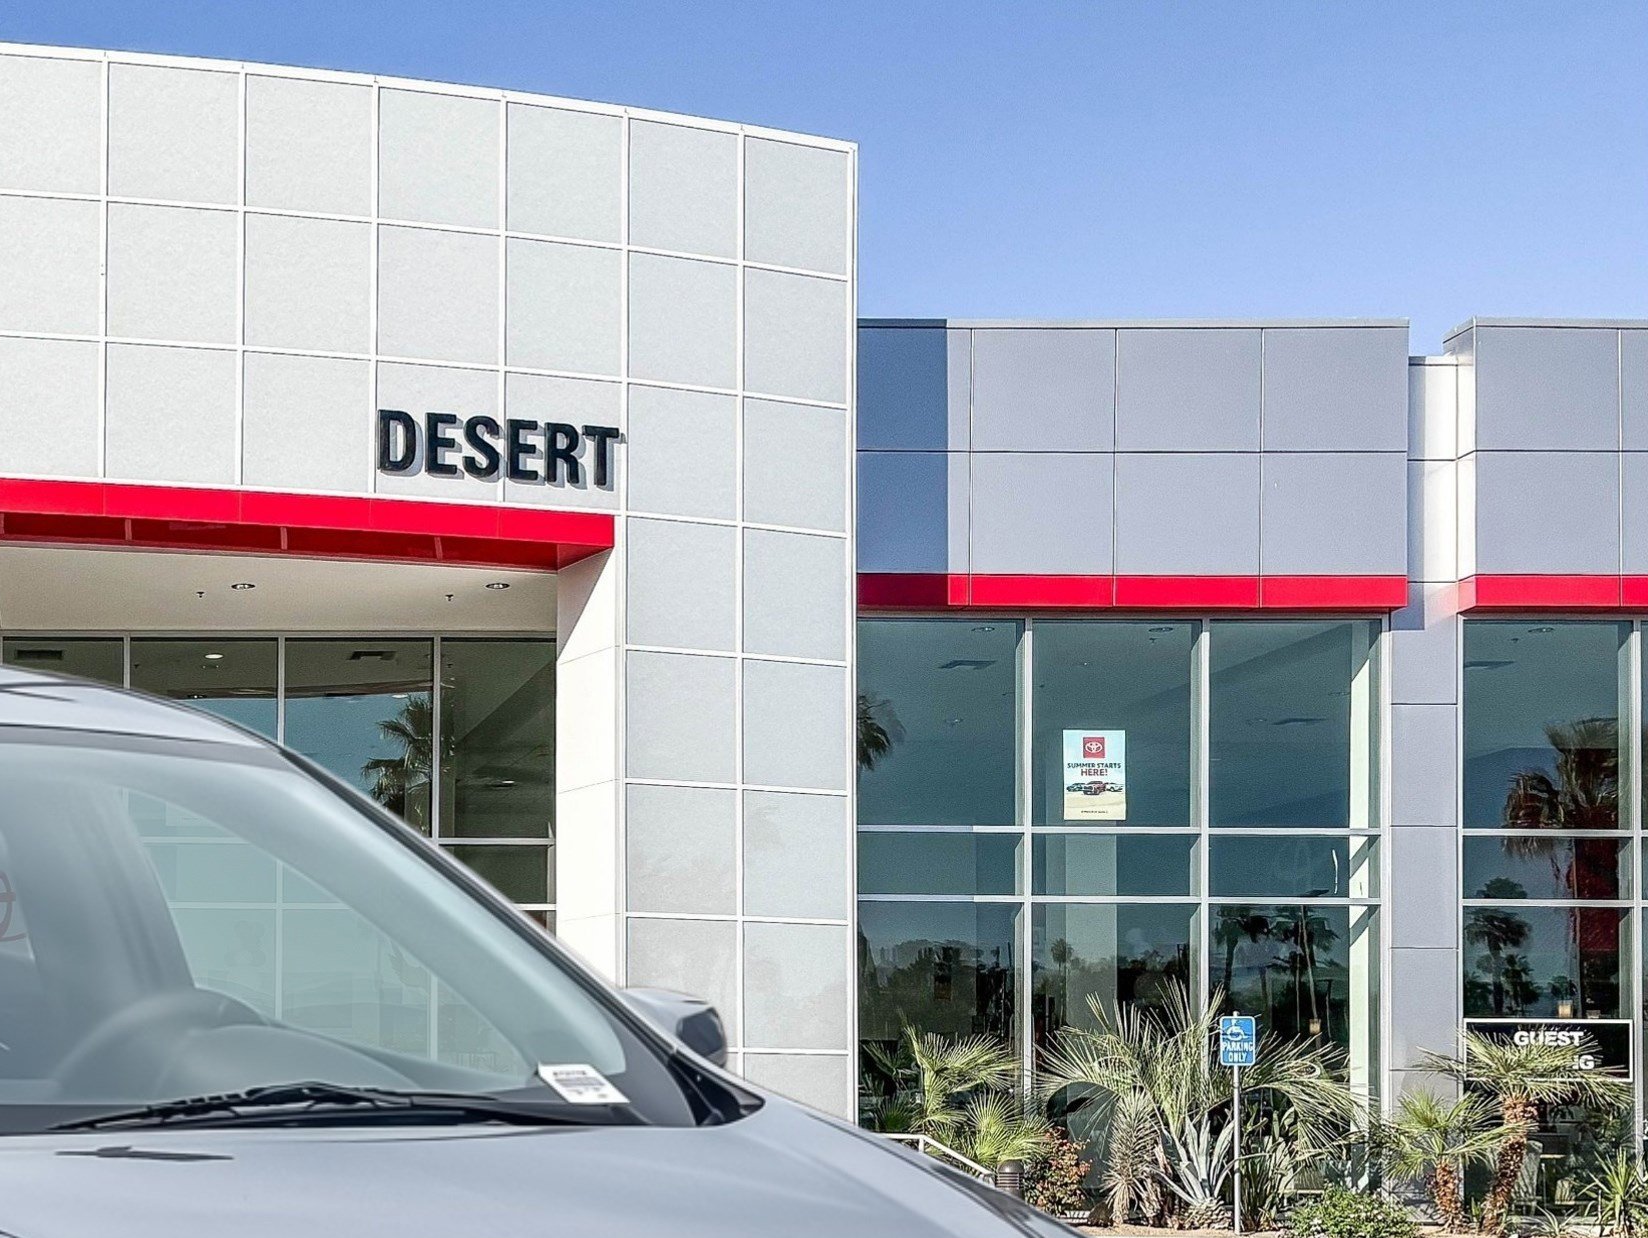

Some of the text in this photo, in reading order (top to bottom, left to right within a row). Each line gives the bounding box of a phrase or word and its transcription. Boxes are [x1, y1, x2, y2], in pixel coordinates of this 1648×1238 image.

[377, 409, 620, 487] DESERT
[1514, 1031, 1584, 1046] GUEST
[1222, 1041, 1253, 1051] PARKING
[1228, 1052, 1247, 1062] ONLY
